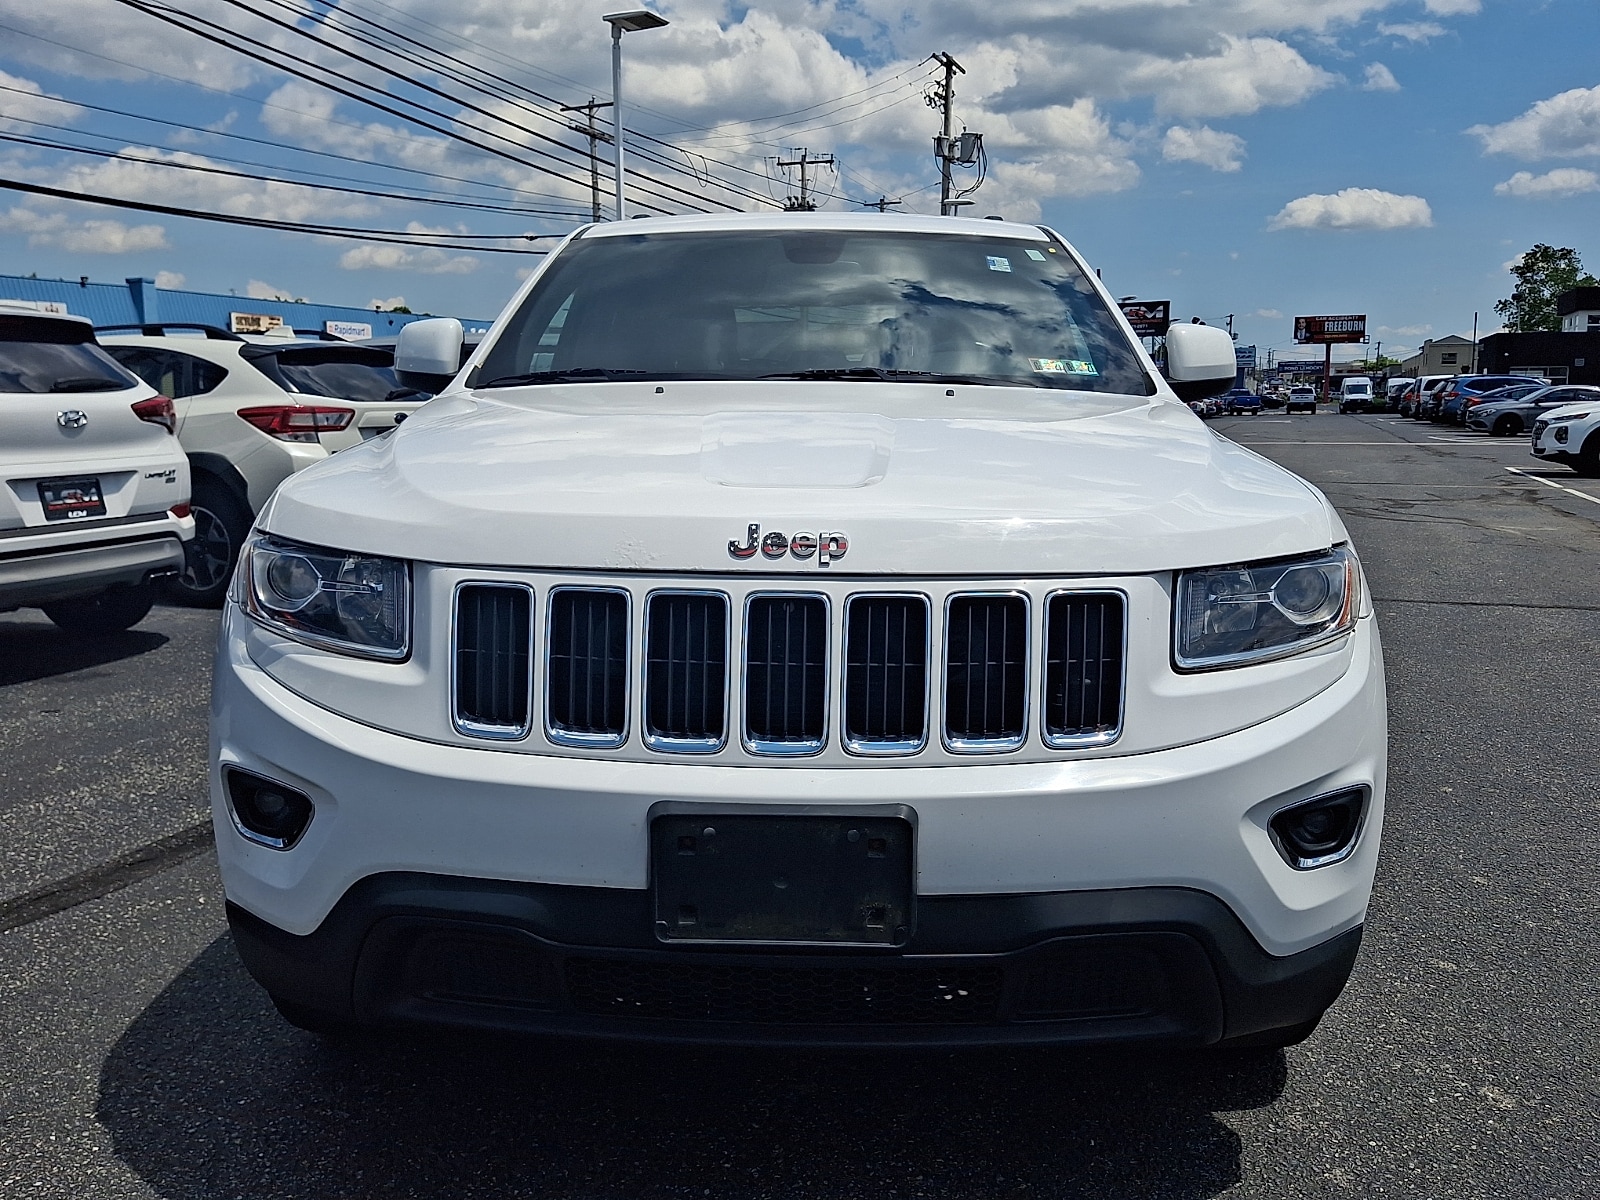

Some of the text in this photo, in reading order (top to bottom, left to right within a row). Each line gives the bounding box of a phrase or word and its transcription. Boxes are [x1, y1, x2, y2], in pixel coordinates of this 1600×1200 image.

[334, 324, 365, 337] Rapidmart
[1324, 321, 1364, 332] FREEBURN
[727, 523, 849, 568] Jeep
